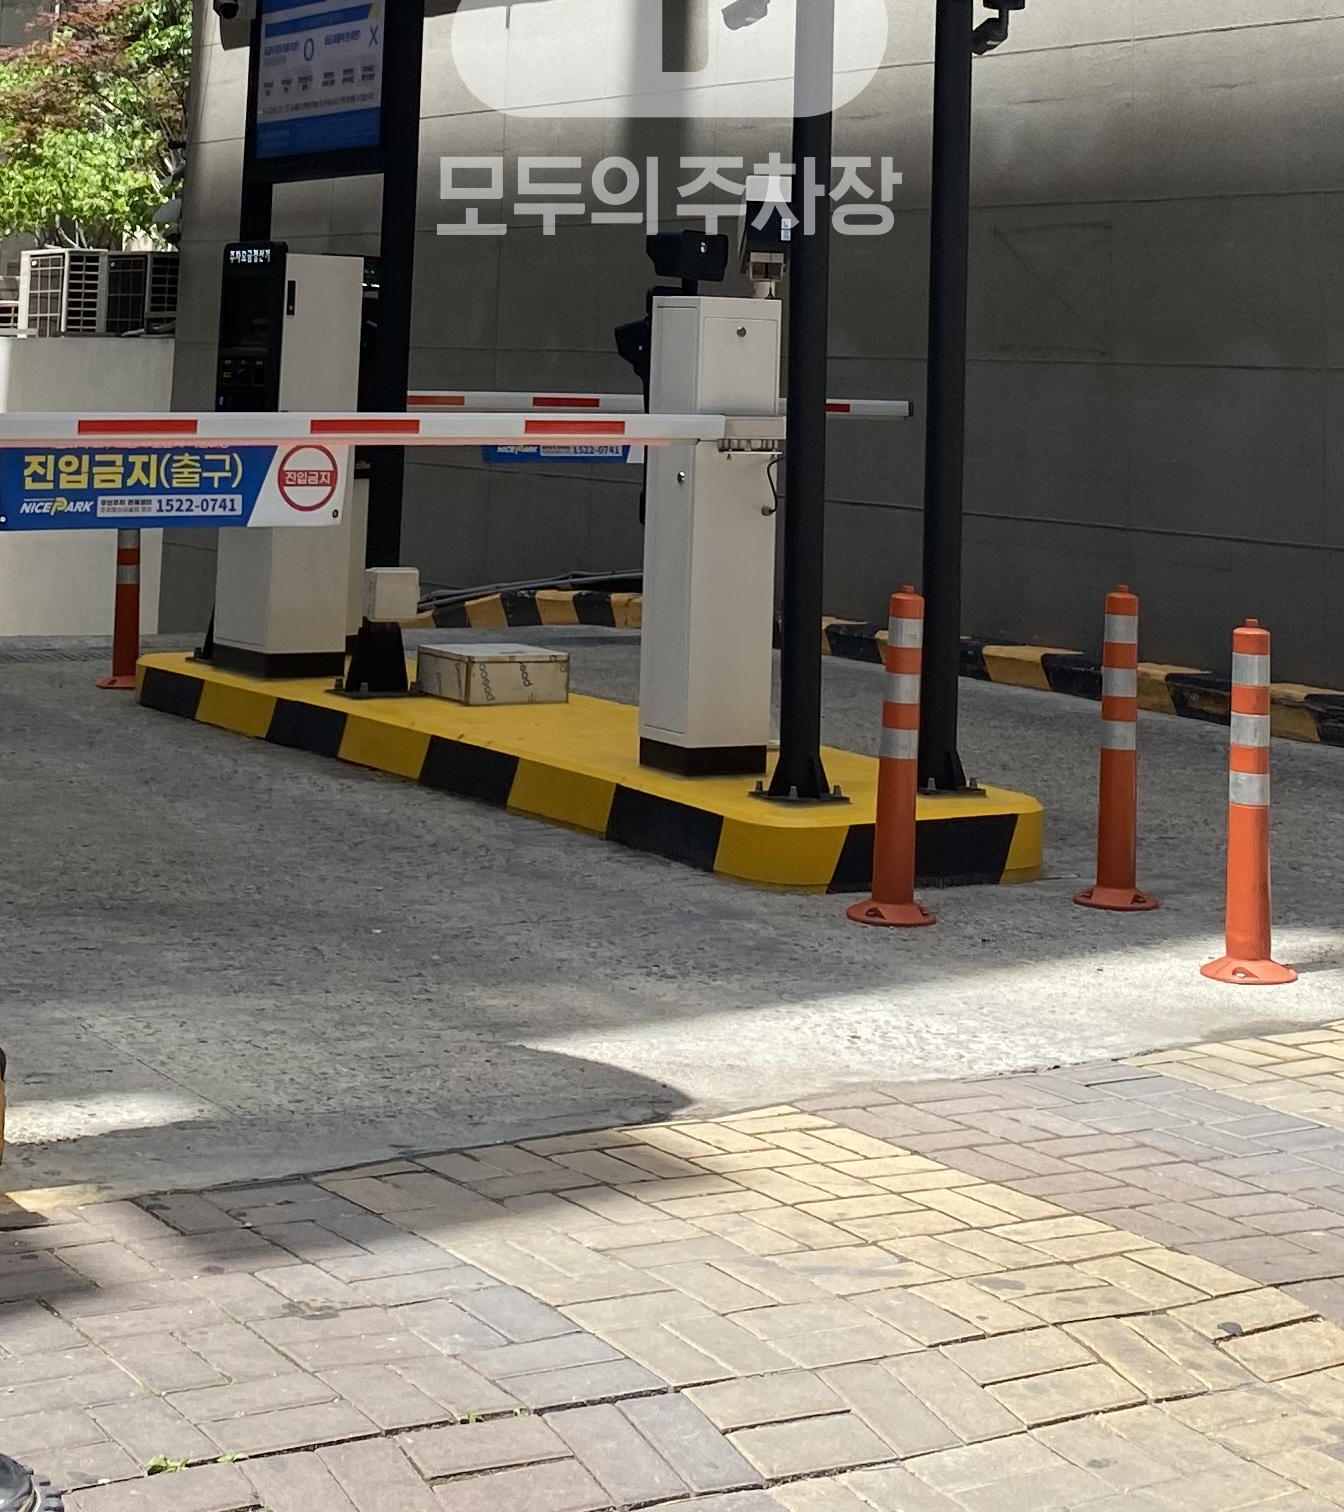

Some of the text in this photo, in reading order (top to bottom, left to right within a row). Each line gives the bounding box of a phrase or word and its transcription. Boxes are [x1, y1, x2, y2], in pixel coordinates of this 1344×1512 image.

[23, 452, 243, 490] 진입금지(출구)
[284, 470, 332, 487] 진입금지
[20, 496, 94, 516] NICEPARK
[155, 497, 237, 514] 1522-0741
